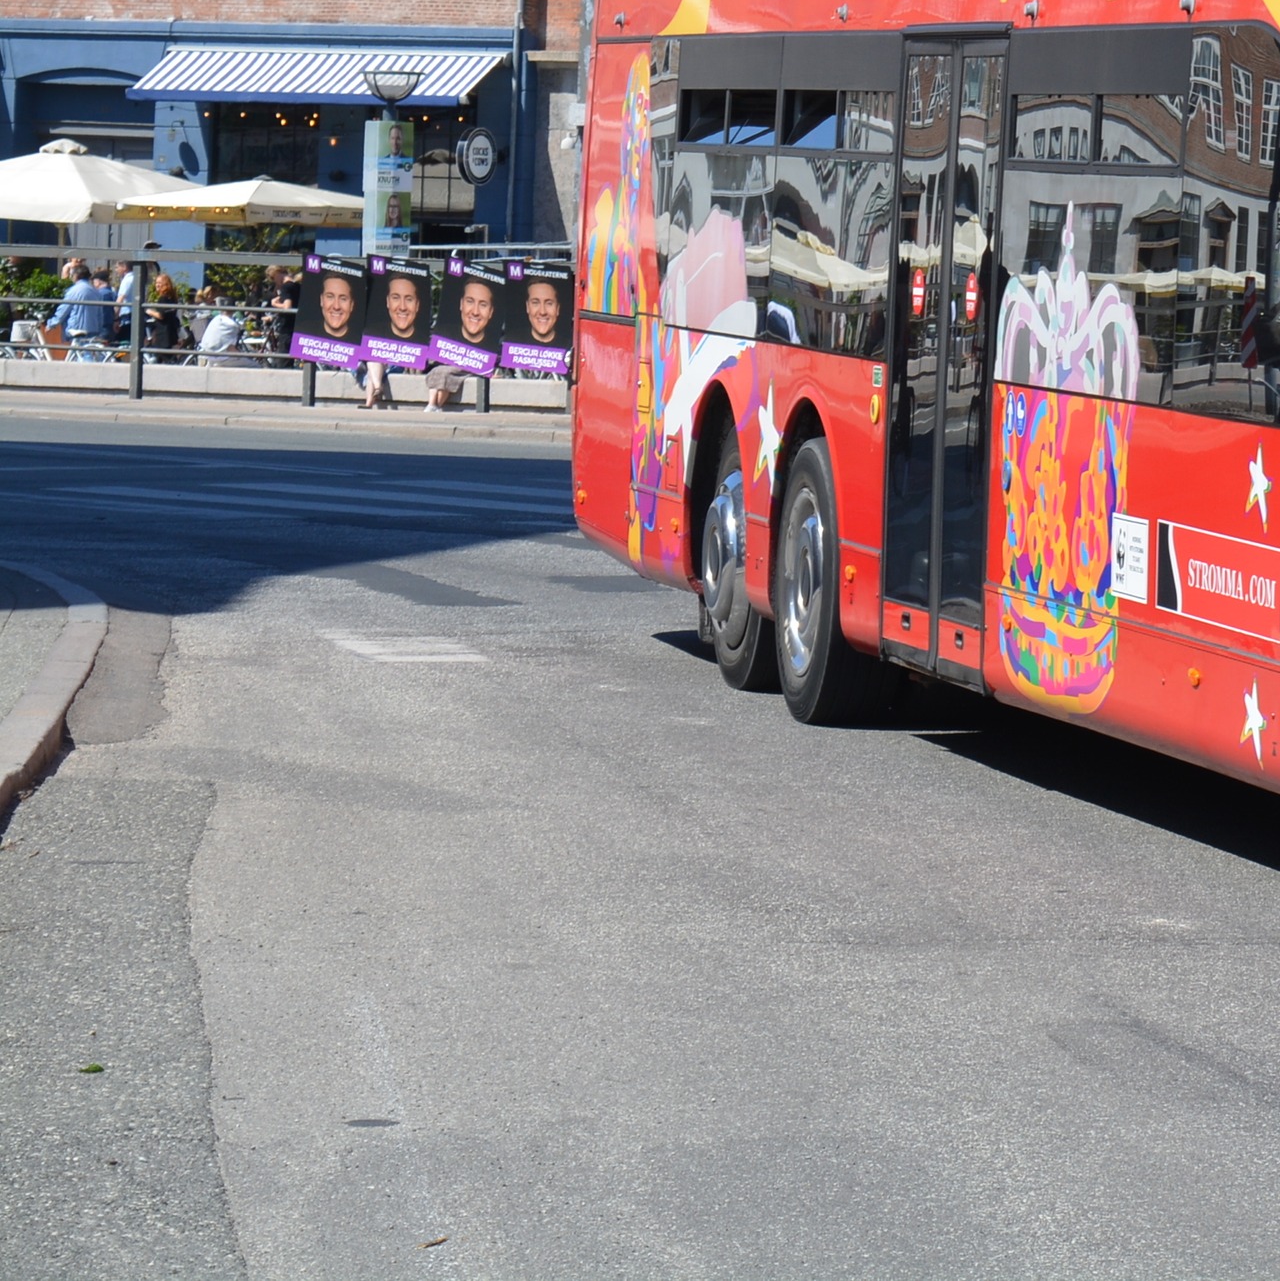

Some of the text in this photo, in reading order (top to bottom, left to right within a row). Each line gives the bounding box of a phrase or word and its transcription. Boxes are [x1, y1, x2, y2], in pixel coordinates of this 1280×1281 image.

[308, 257, 319, 270] M
[372, 259, 384, 271] M
[450, 261, 462, 273] M
[510, 265, 521, 277] M
[302, 347, 348, 363] RASMUSSEN
[371, 349, 415, 363] RASMUSSEN
[438, 349, 483, 369] RASMUSSEN
[512, 355, 558, 368] RASMUSSEN
[1187, 558, 1277, 610] STROMMA.COM
